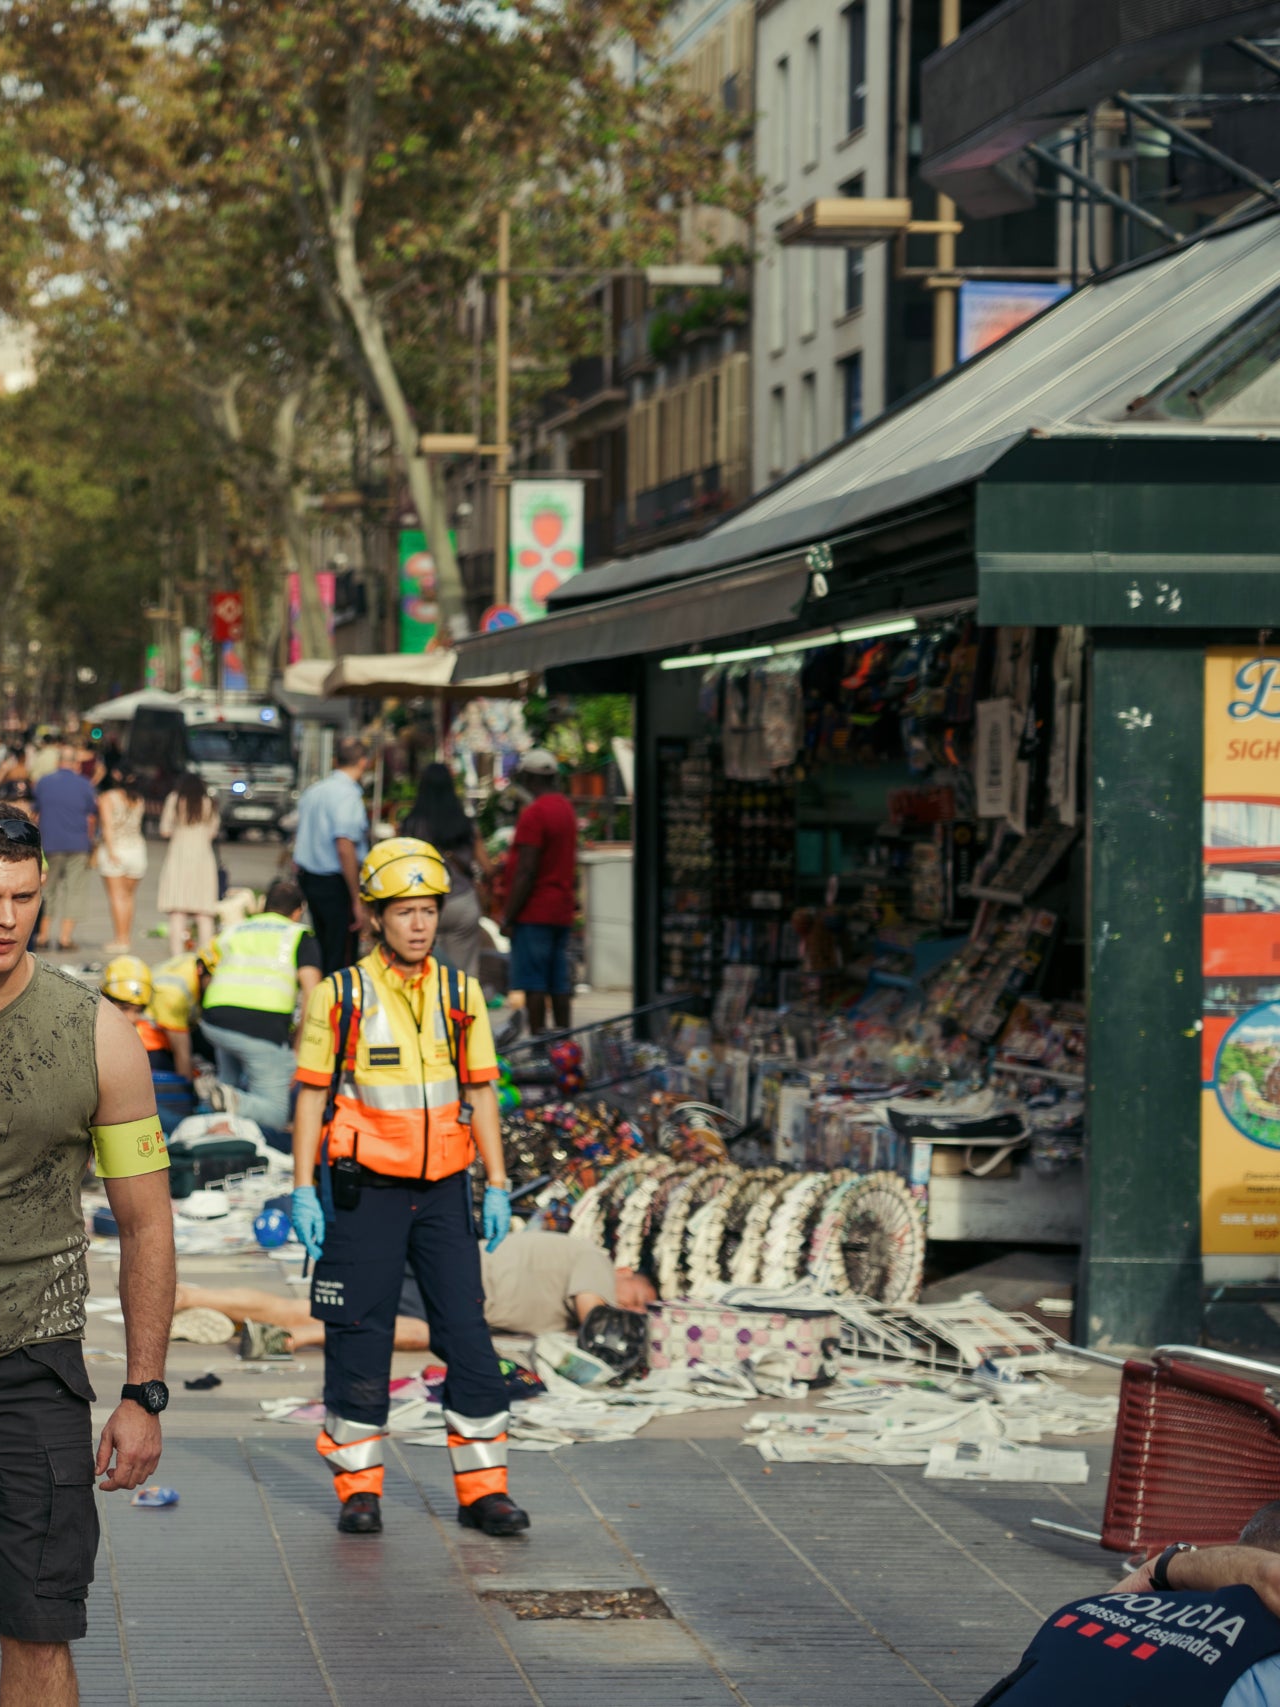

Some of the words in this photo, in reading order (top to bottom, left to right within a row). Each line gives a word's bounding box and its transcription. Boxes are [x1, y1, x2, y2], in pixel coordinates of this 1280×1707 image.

[1076, 1602, 1137, 1629] mossos
[1131, 1621, 1222, 1666] d'esquadra
[1099, 1592, 1246, 1647] POLICIA
